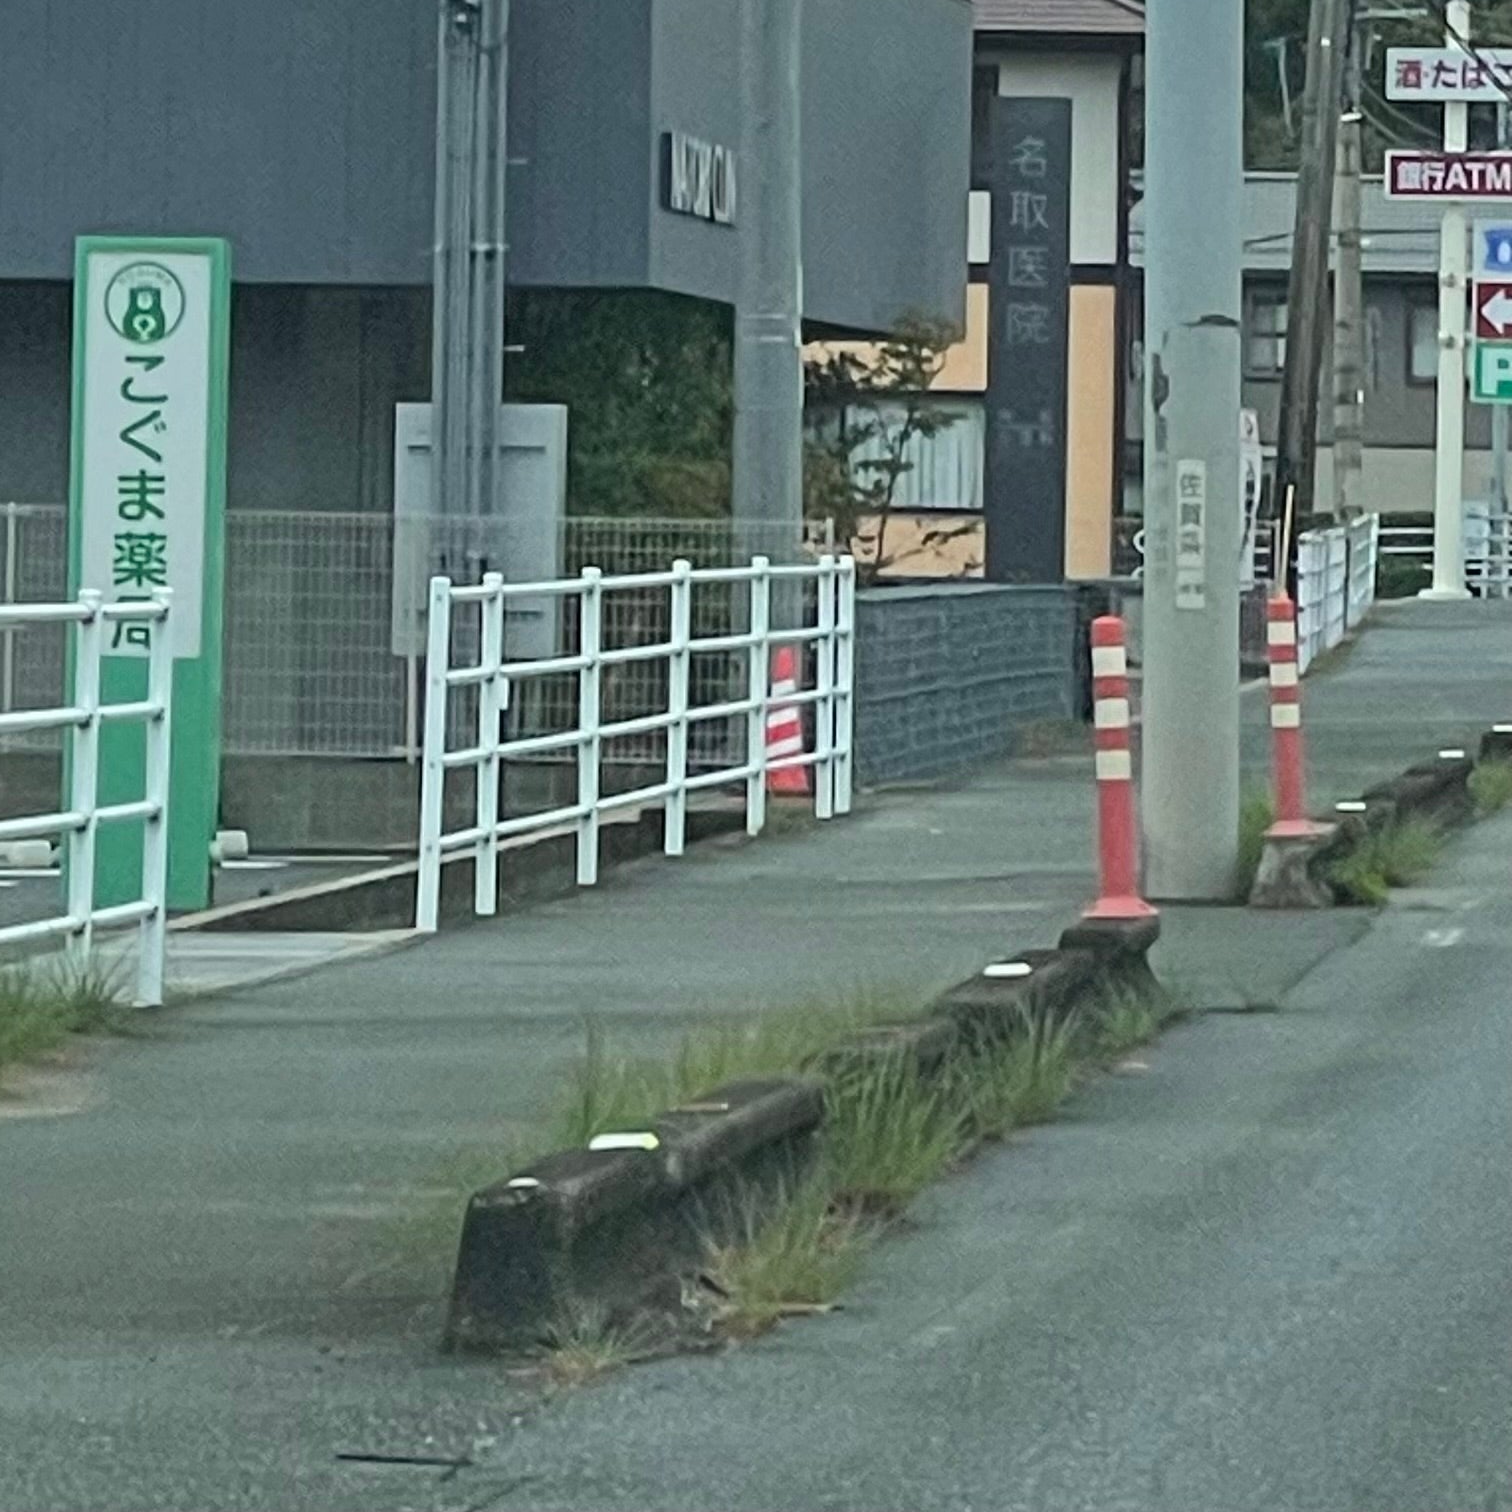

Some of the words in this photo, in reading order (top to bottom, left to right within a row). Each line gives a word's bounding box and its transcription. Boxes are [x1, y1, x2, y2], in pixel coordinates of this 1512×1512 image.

[1396, 160, 1511, 192] 銀行ATM
[1007, 135, 1050, 345] 名取医院
